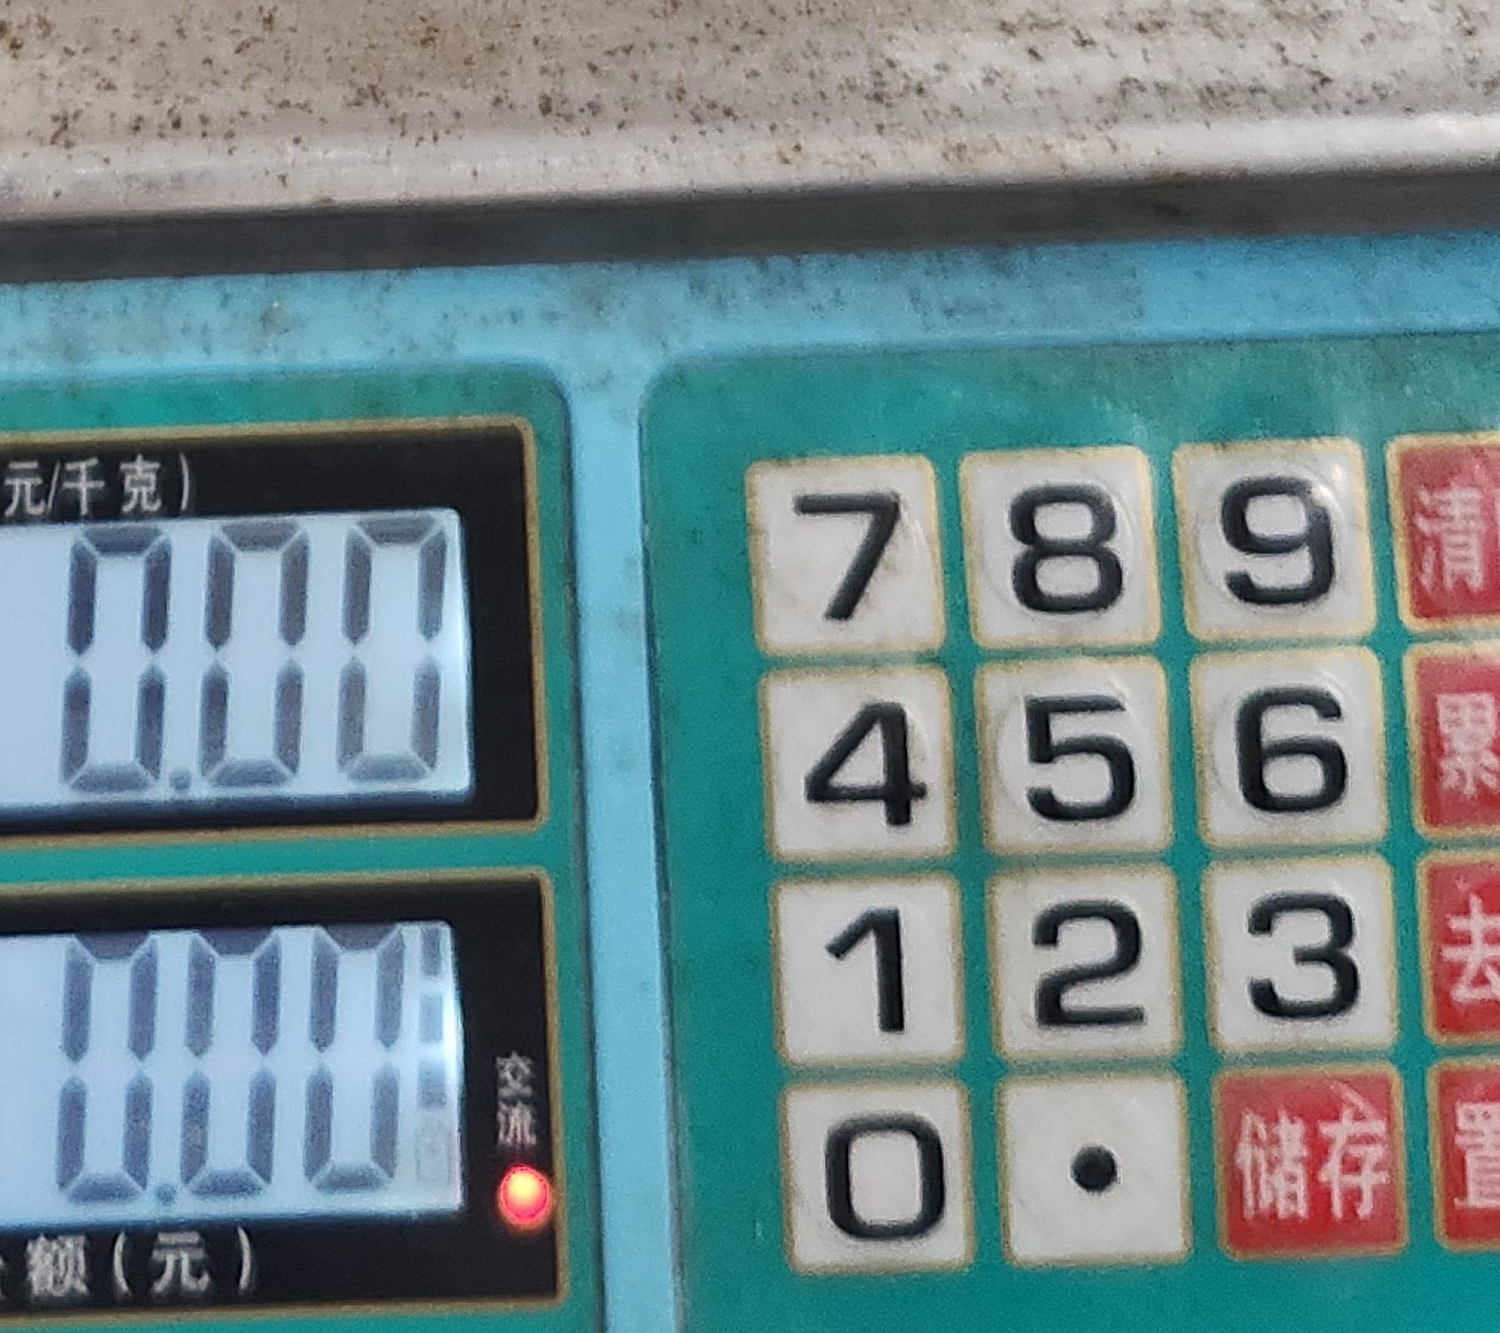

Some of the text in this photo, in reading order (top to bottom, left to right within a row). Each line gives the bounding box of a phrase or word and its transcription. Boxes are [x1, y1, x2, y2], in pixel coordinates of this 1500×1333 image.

[793, 476, 1337, 621] 7 8 9
[1414, 478, 1500, 595] 清
[59, 514, 448, 794] 0.00
[804, 687, 1349, 827] 4 5 6
[826, 891, 1360, 1034] 1 2 3
[55, 925, 405, 1204] 0.00
[825, 1112, 946, 1241] 0
[1234, 1103, 1392, 1223] 储存
